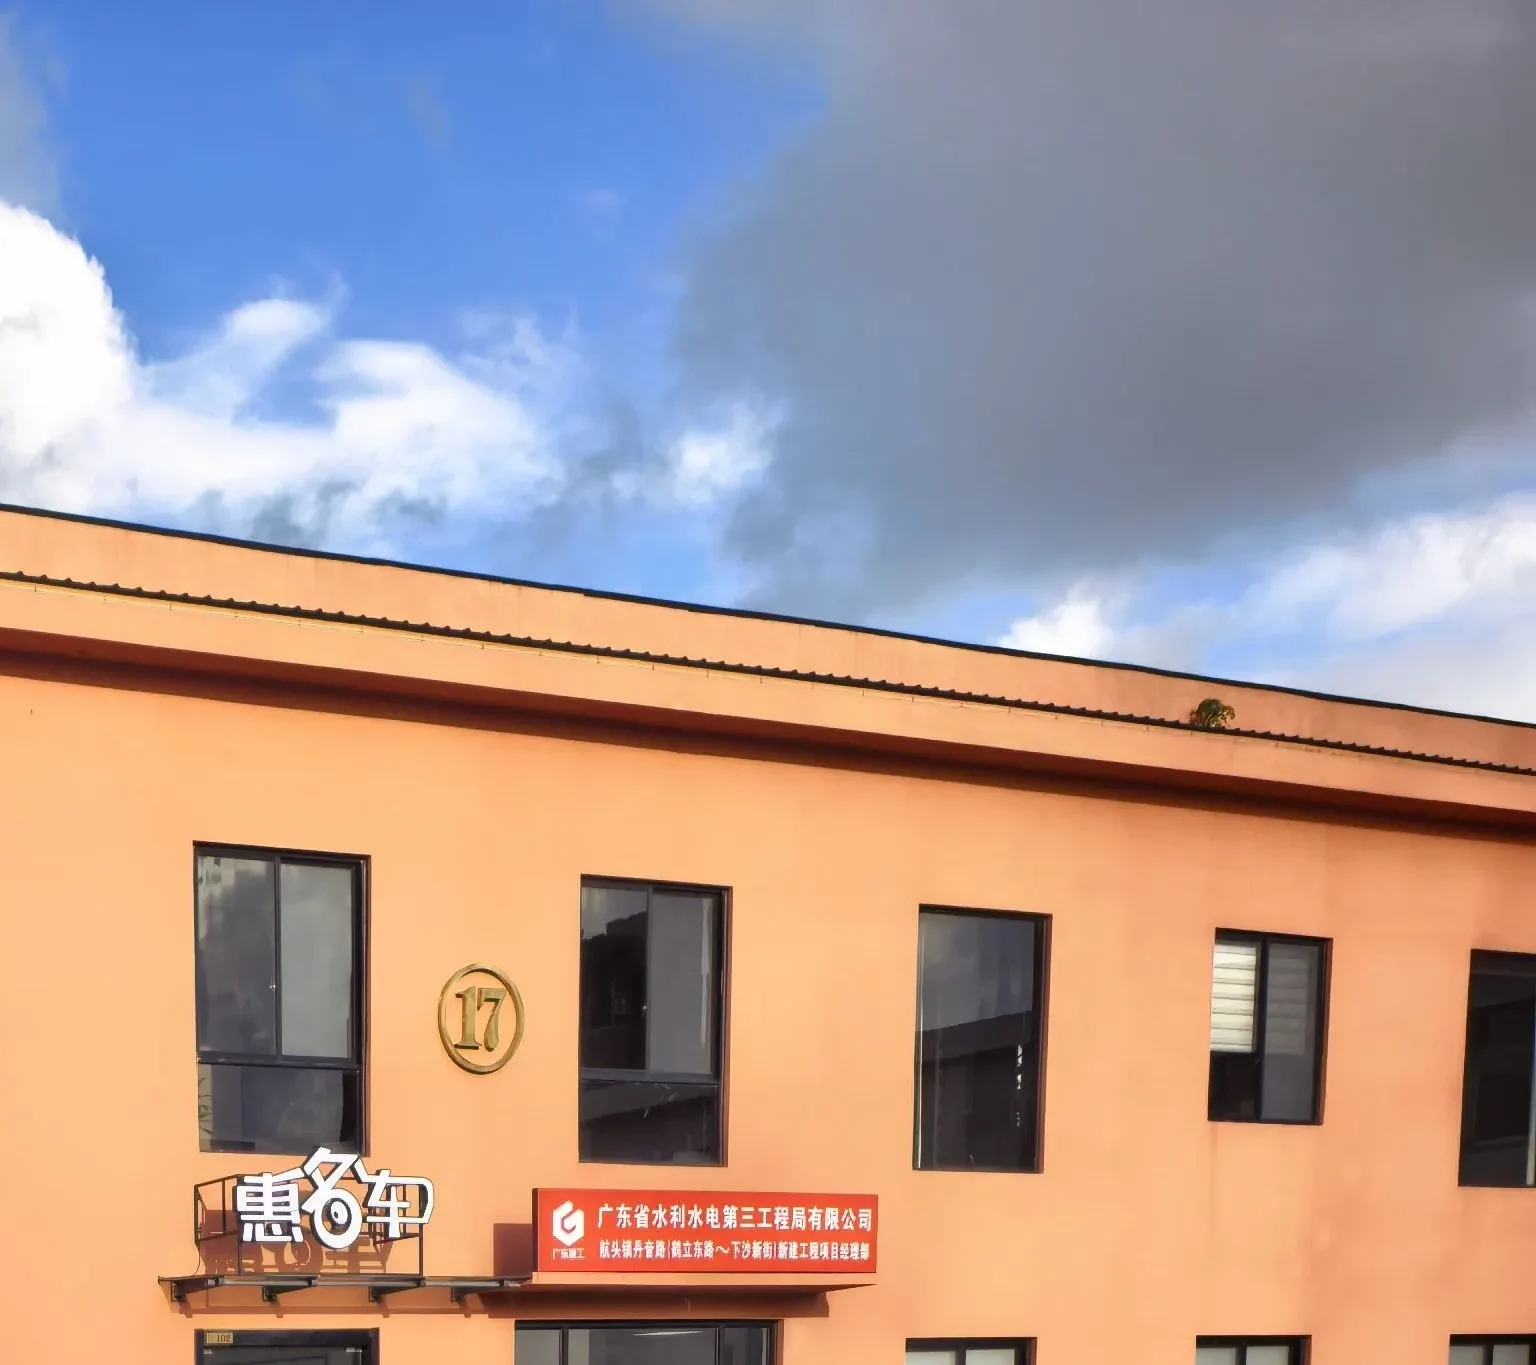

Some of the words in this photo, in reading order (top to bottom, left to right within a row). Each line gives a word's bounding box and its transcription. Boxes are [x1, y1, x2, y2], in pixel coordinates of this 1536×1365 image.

[454, 986, 507, 1052] 17
[597, 1203, 873, 1232] 广东省水利水电第三工程局有限公司
